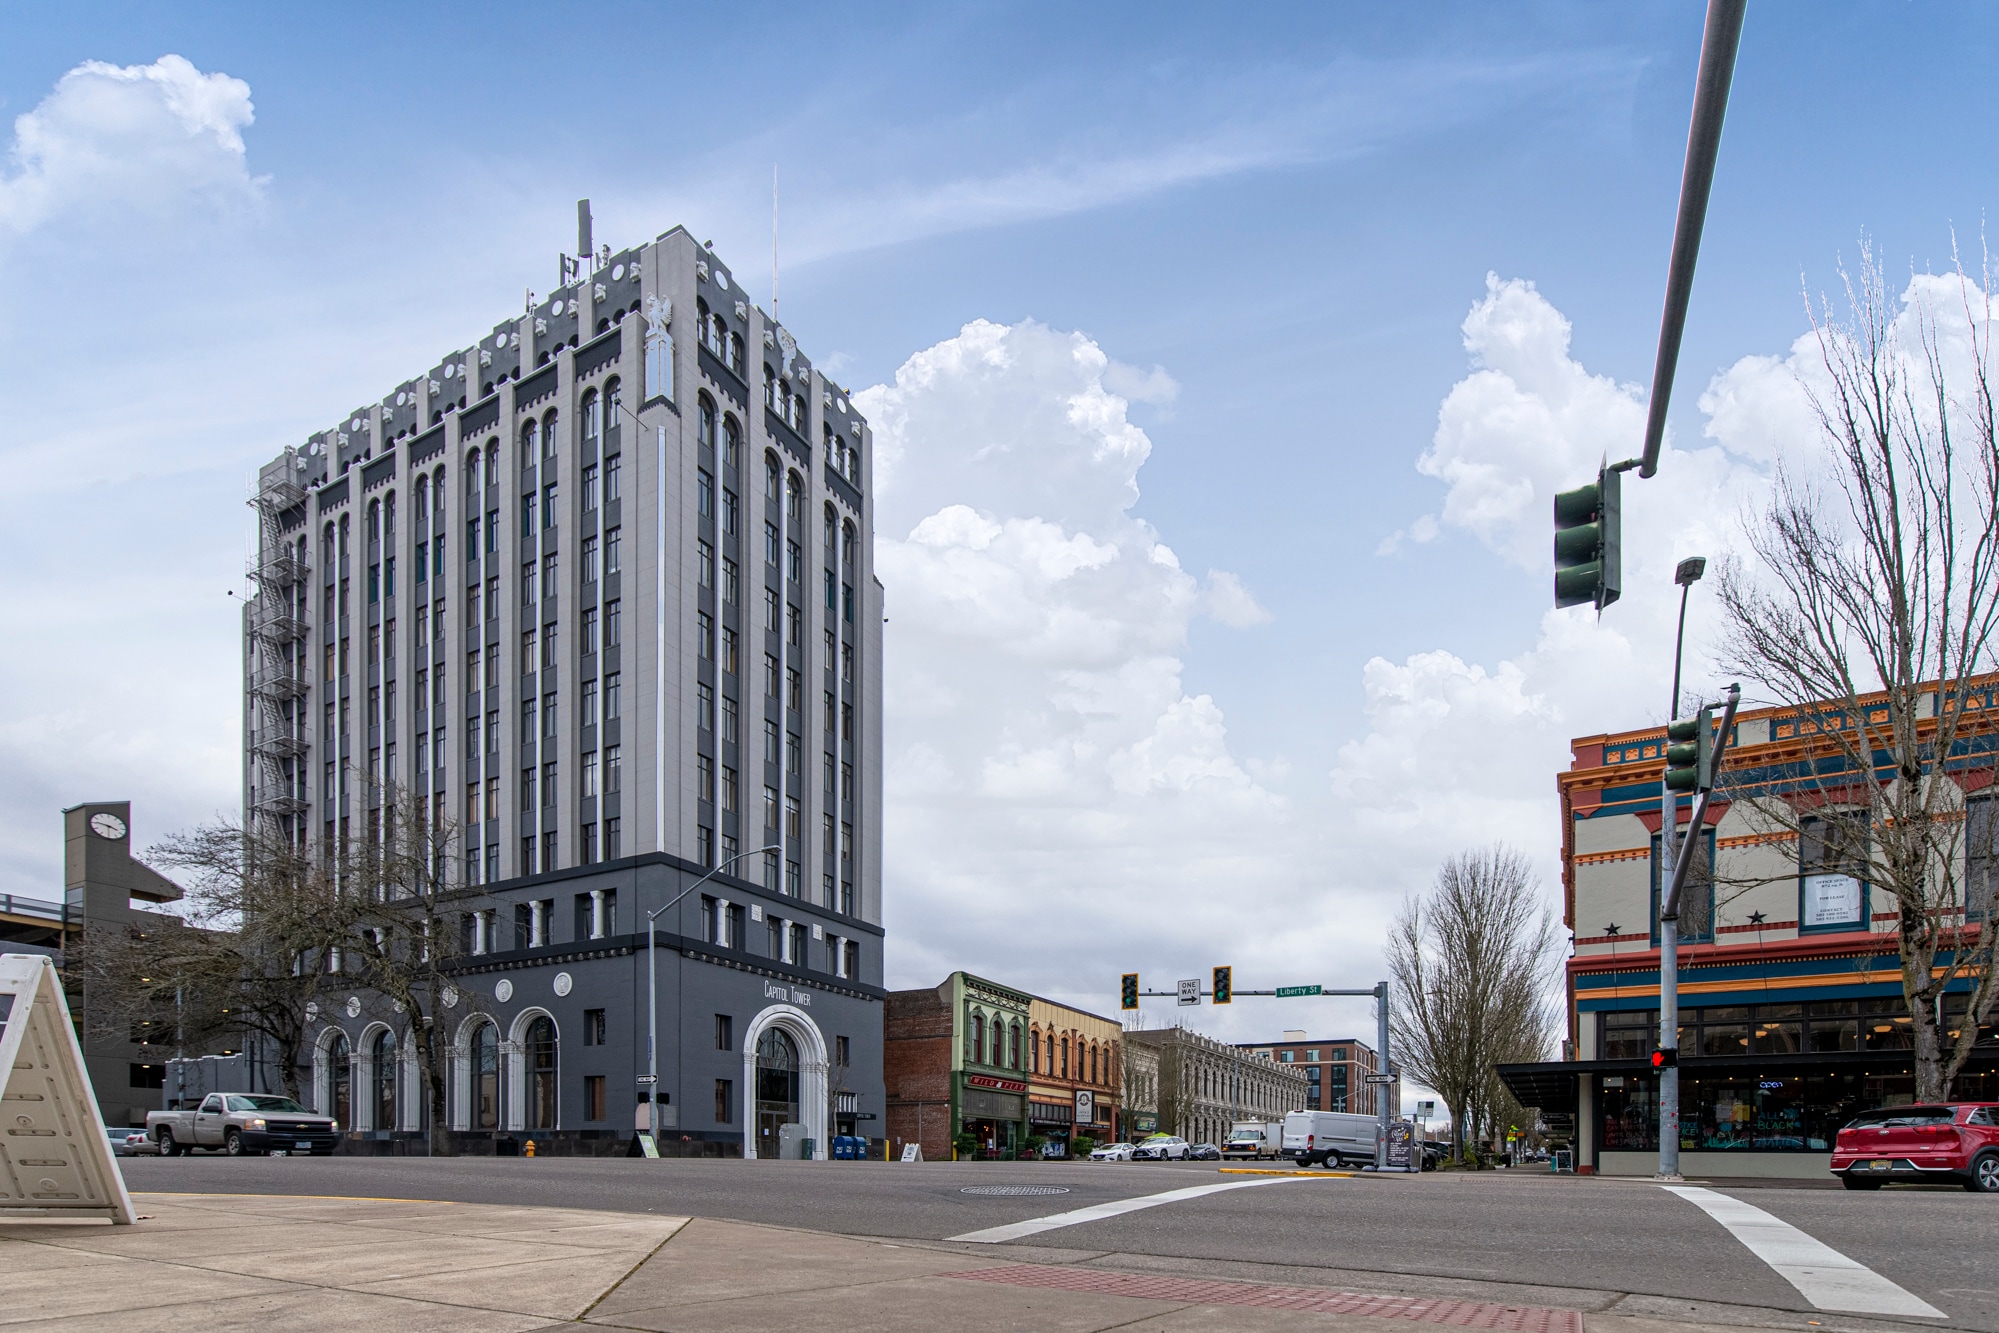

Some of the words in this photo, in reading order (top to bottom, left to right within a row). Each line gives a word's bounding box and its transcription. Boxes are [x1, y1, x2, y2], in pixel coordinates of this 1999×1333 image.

[1280, 986, 1306, 995] Liberty
[1309, 985, 1318, 994] St
[973, 1078, 995, 1086] WILD
[1757, 1120, 1794, 1130] BLACK
